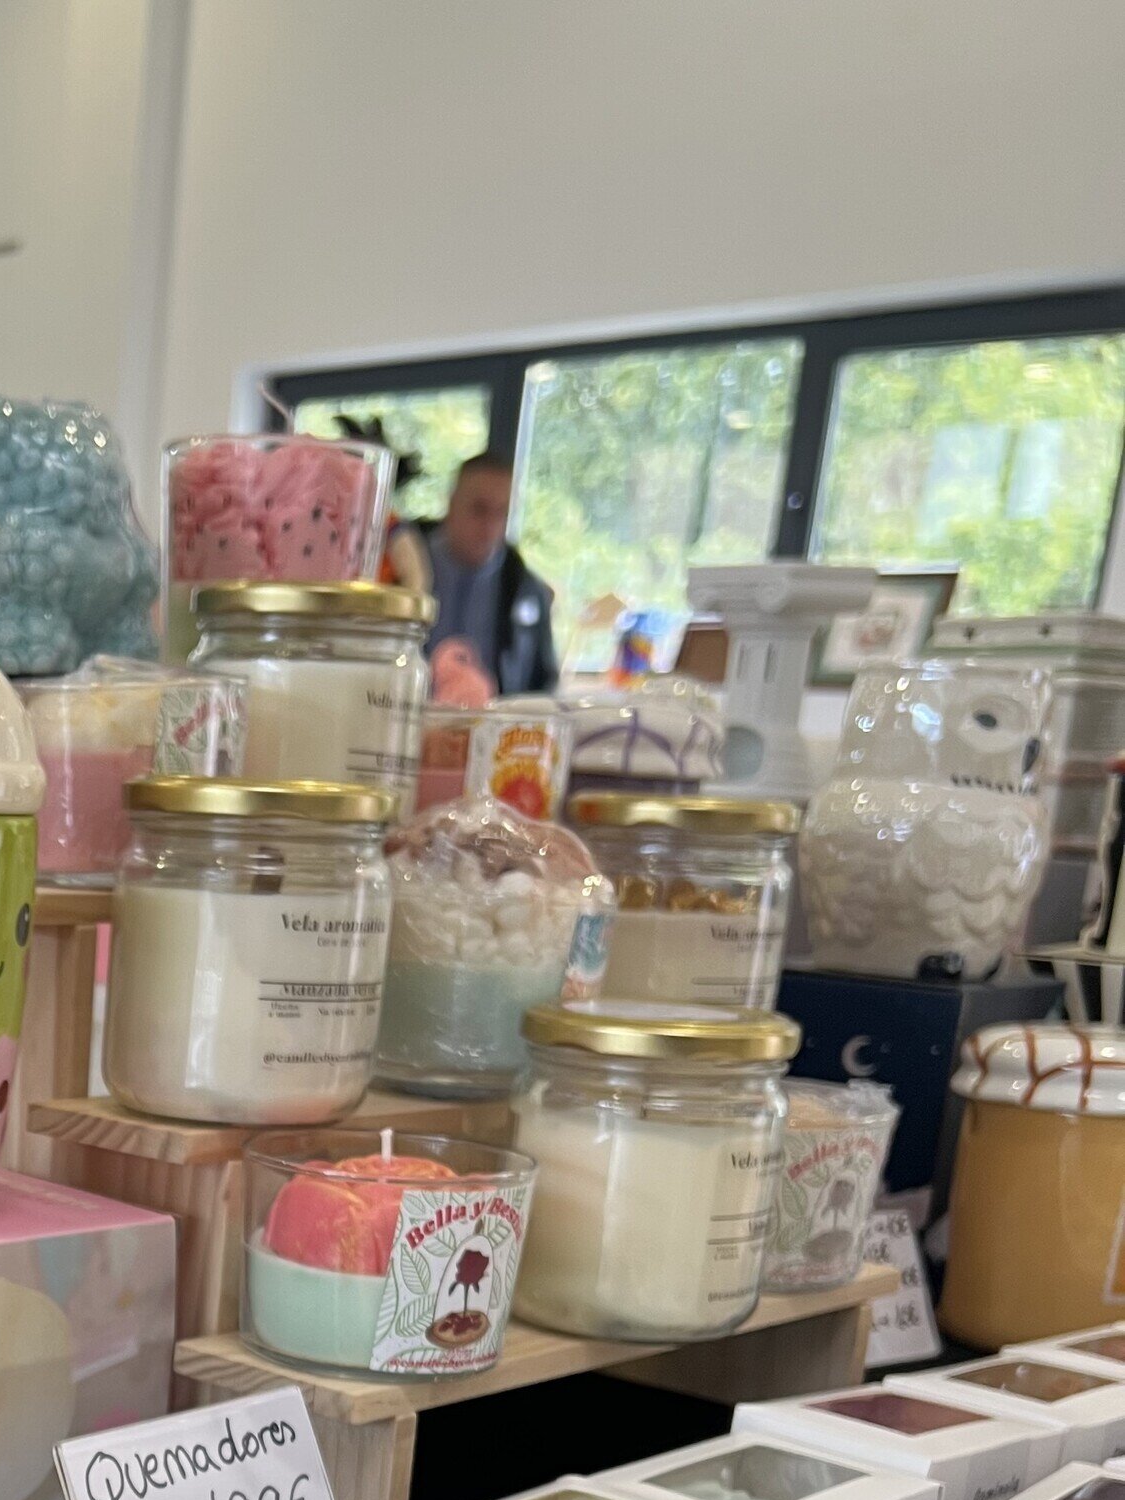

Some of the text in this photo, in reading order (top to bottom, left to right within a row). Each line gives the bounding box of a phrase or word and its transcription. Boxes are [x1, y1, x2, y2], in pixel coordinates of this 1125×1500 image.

[281, 913, 319, 932] Vela
[405, 1205, 467, 1249] Bella
[469, 1201, 486, 1220] y
